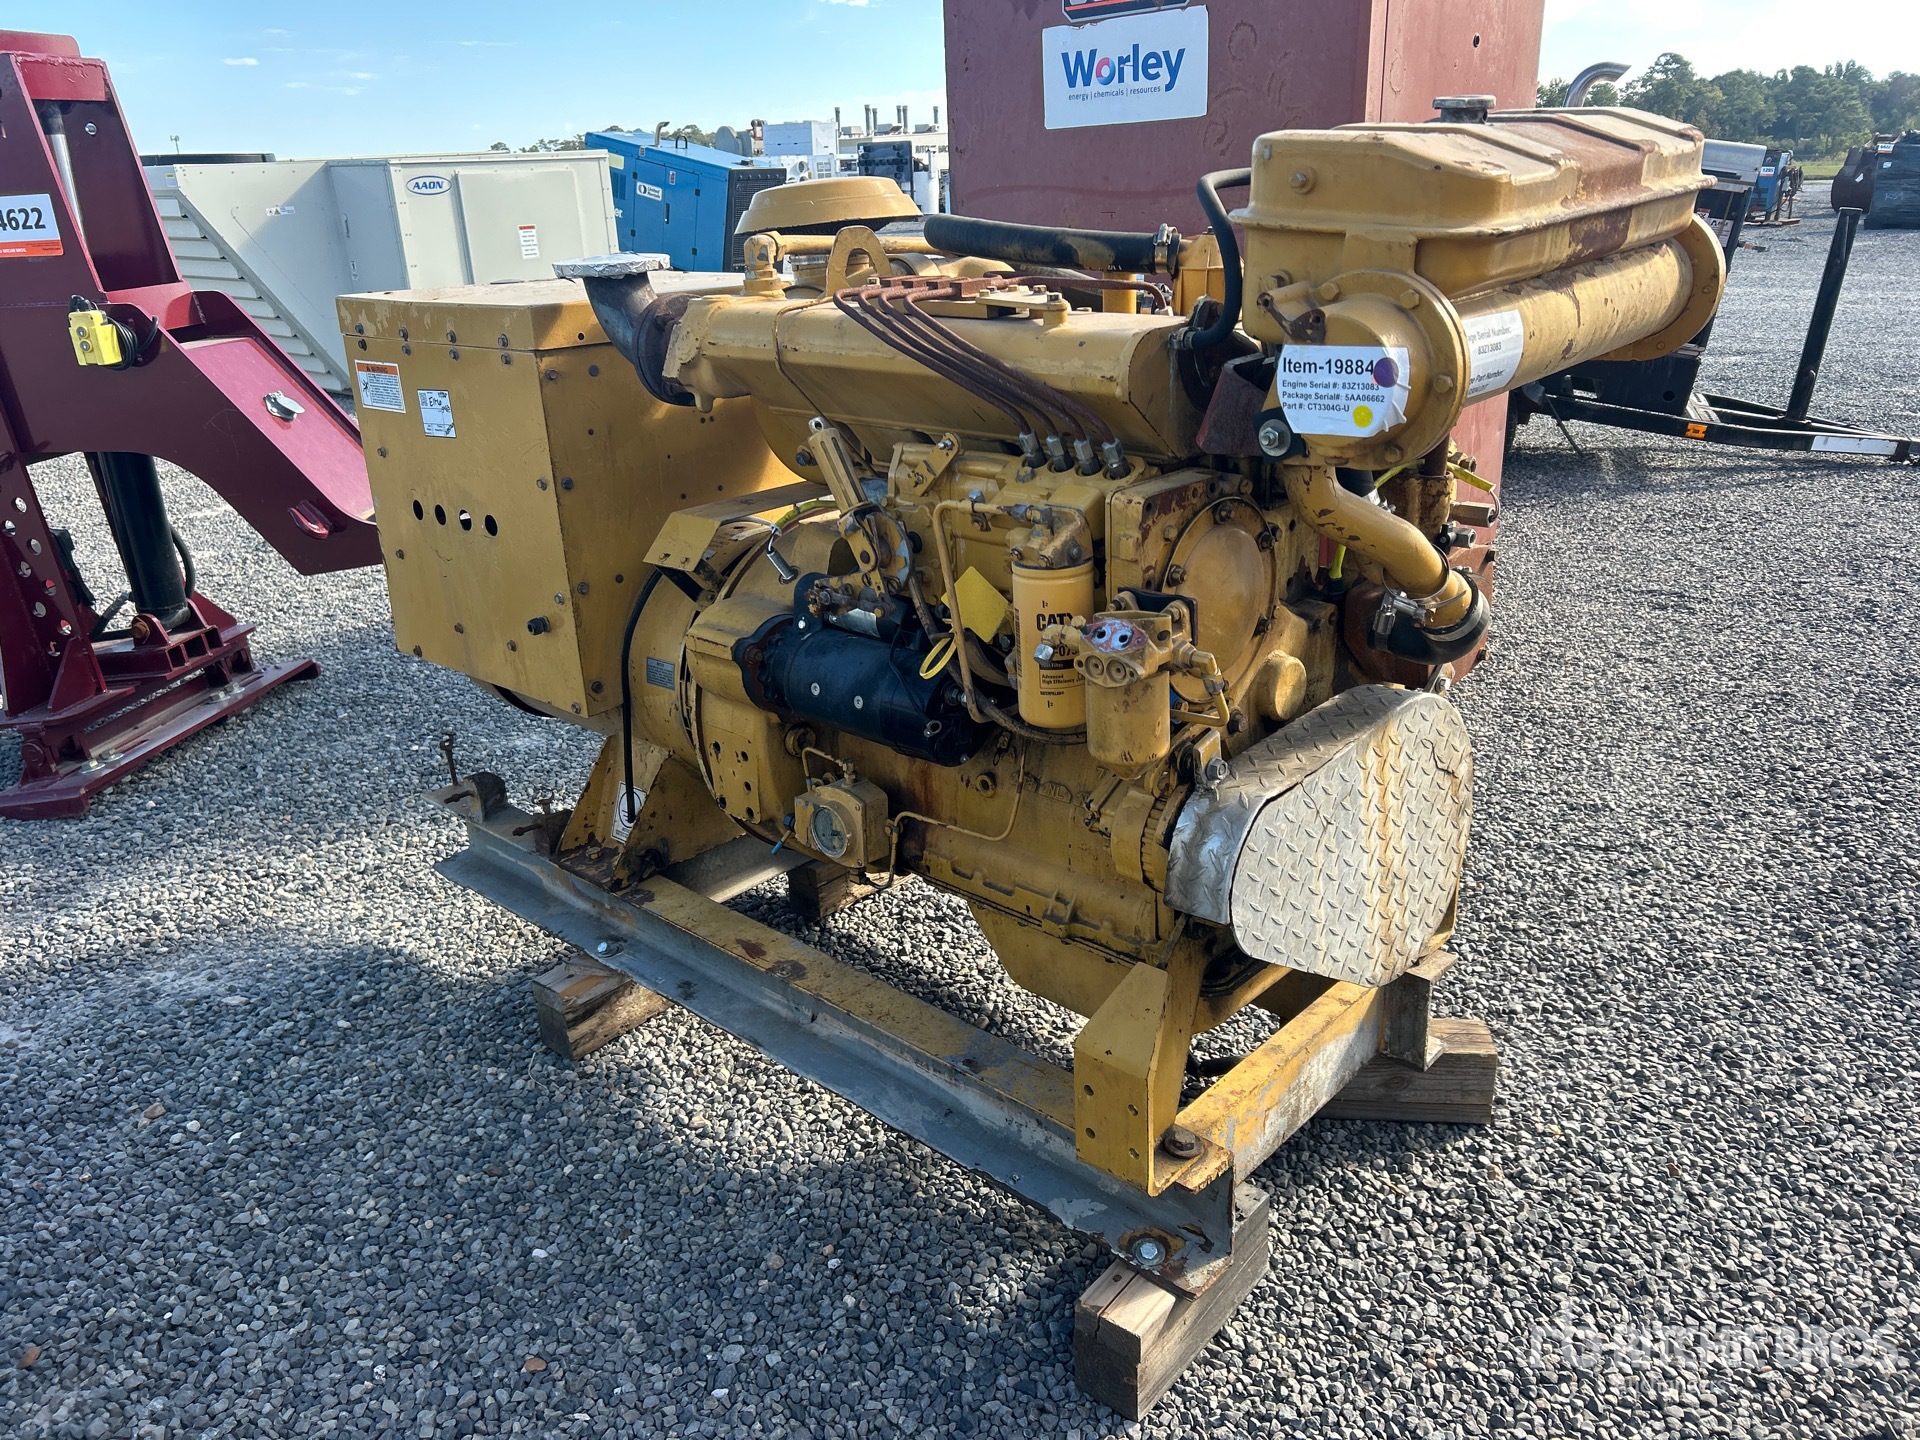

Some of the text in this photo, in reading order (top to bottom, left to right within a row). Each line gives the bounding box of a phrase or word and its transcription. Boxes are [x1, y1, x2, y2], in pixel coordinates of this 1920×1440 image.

[1061, 43, 1186, 92] Worley
[1068, 85, 1161, 101] energy chemicals resources
[413, 181, 443, 190] AAON
[1477, 328, 1491, 340] Serial
[1282, 357, 1375, 376] Item-19884
[1282, 380, 1308, 390] Engine
[1309, 380, 1331, 389] Serial
[1341, 382, 1380, 391] 83Z13083
[1282, 391, 1385, 403] Package Serial#: 5AA06662
[1282, 402, 1297, 410] Part
[1307, 403, 1350, 412] CT3304G-U
[1036, 613, 1067, 632] CAT
